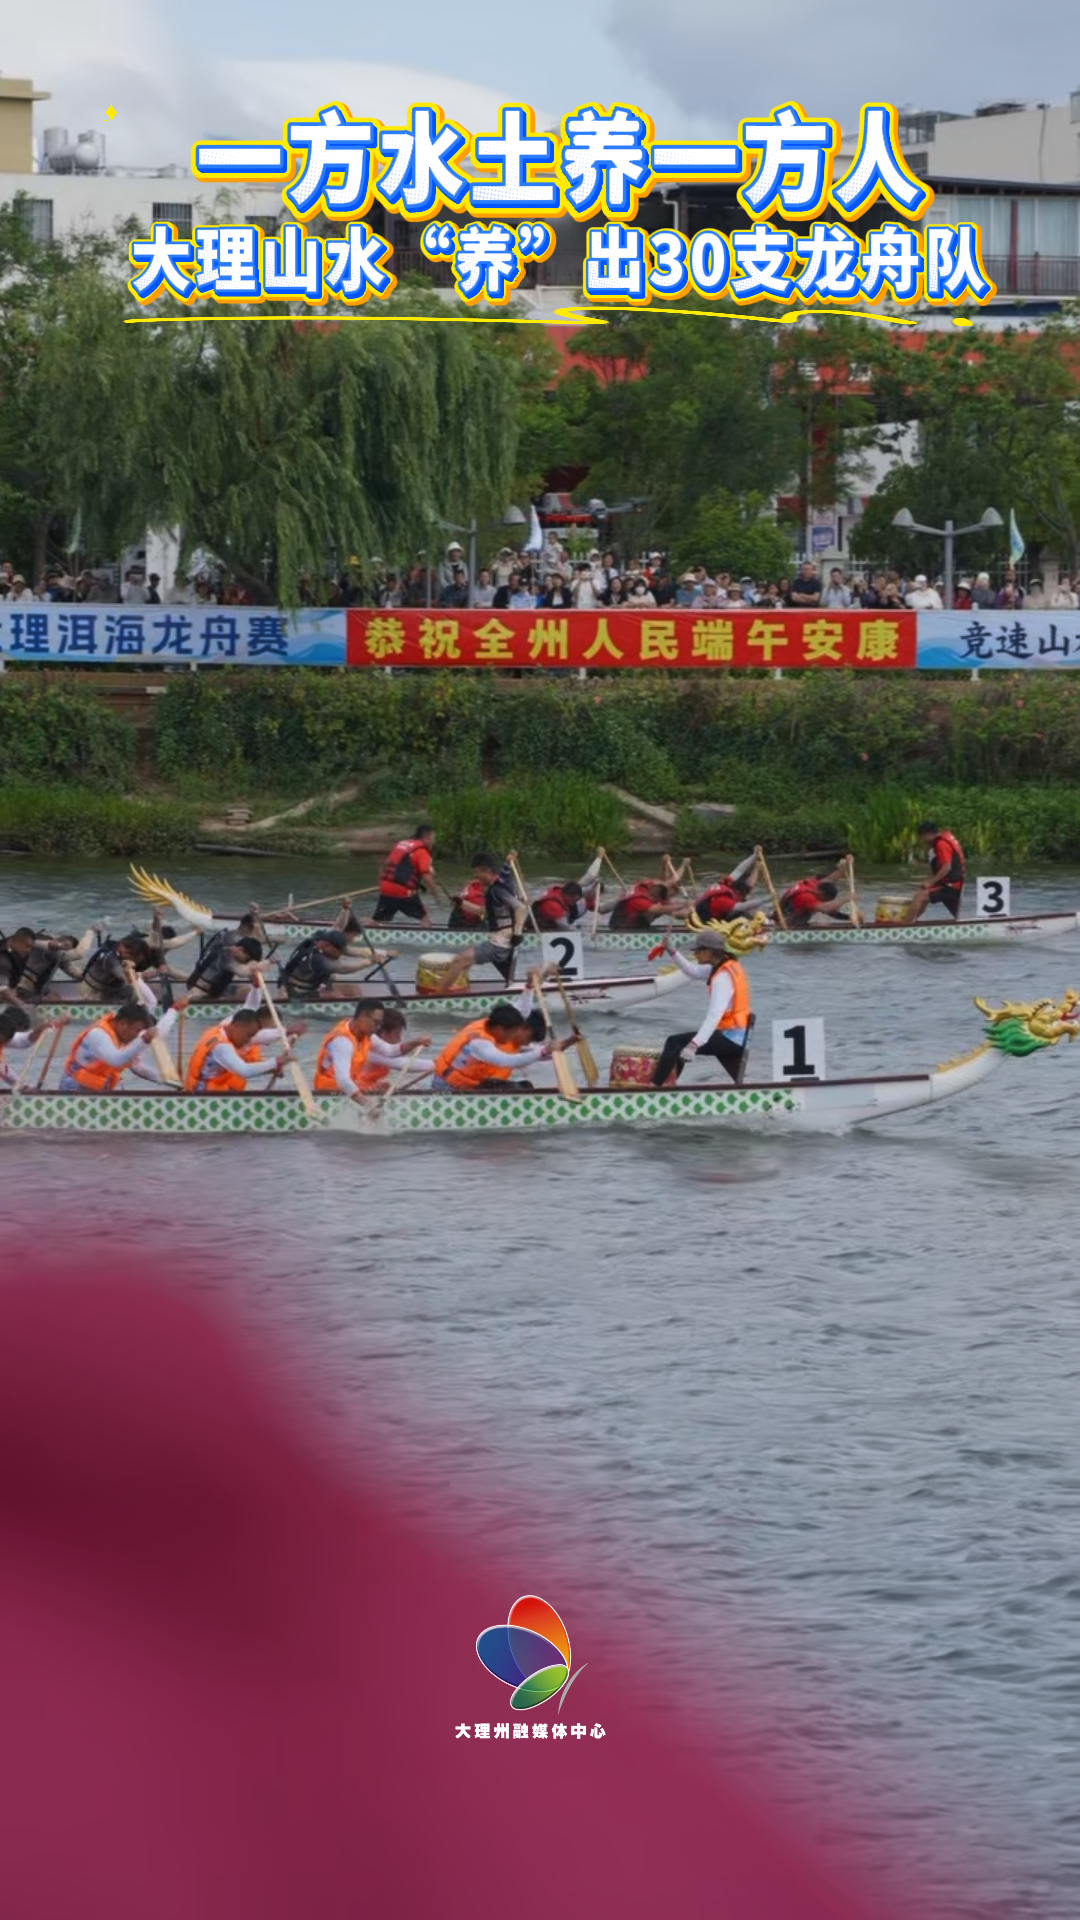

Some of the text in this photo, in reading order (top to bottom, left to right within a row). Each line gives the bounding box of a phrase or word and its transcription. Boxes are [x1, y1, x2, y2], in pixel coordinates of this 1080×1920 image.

[0, 613, 290, 657] 理洱海龙舟赛
[365, 617, 899, 660] 恭祝全州人民端午安康
[982, 881, 1004, 913] 3
[549, 937, 577, 975] 2
[783, 1025, 815, 1075] 1
